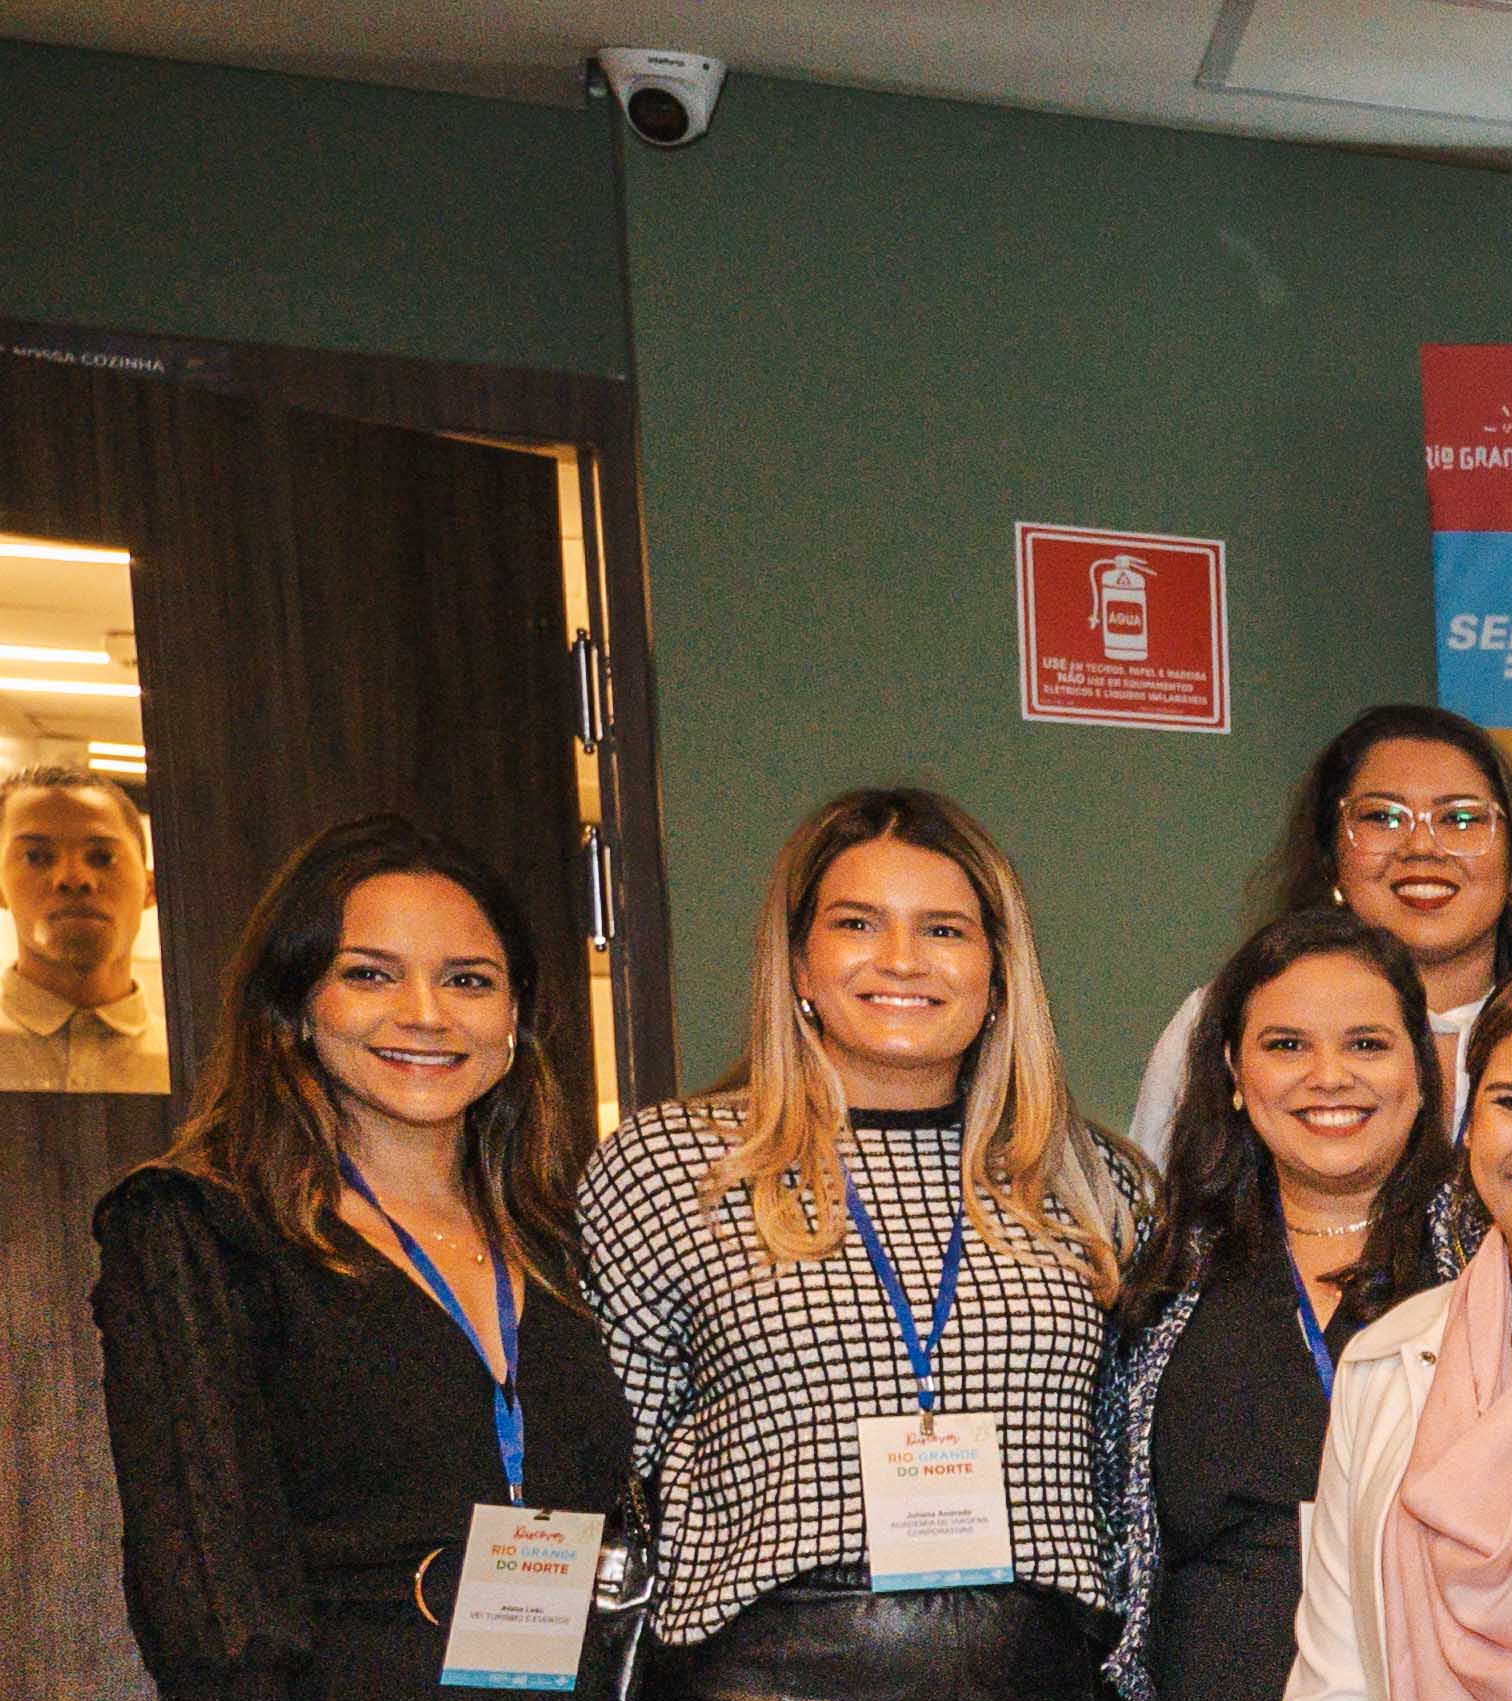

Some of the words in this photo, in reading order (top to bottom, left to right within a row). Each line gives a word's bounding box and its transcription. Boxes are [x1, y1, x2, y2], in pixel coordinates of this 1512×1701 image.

[81, 352, 165, 372] COZINHA
[888, 1452, 914, 1463] RIO
[896, 1466, 919, 1477] DO
[923, 1463, 974, 1476] NORTE
[491, 1544, 517, 1557] RIO
[496, 1559, 518, 1571] DO
[521, 1562, 570, 1575] NORTE
